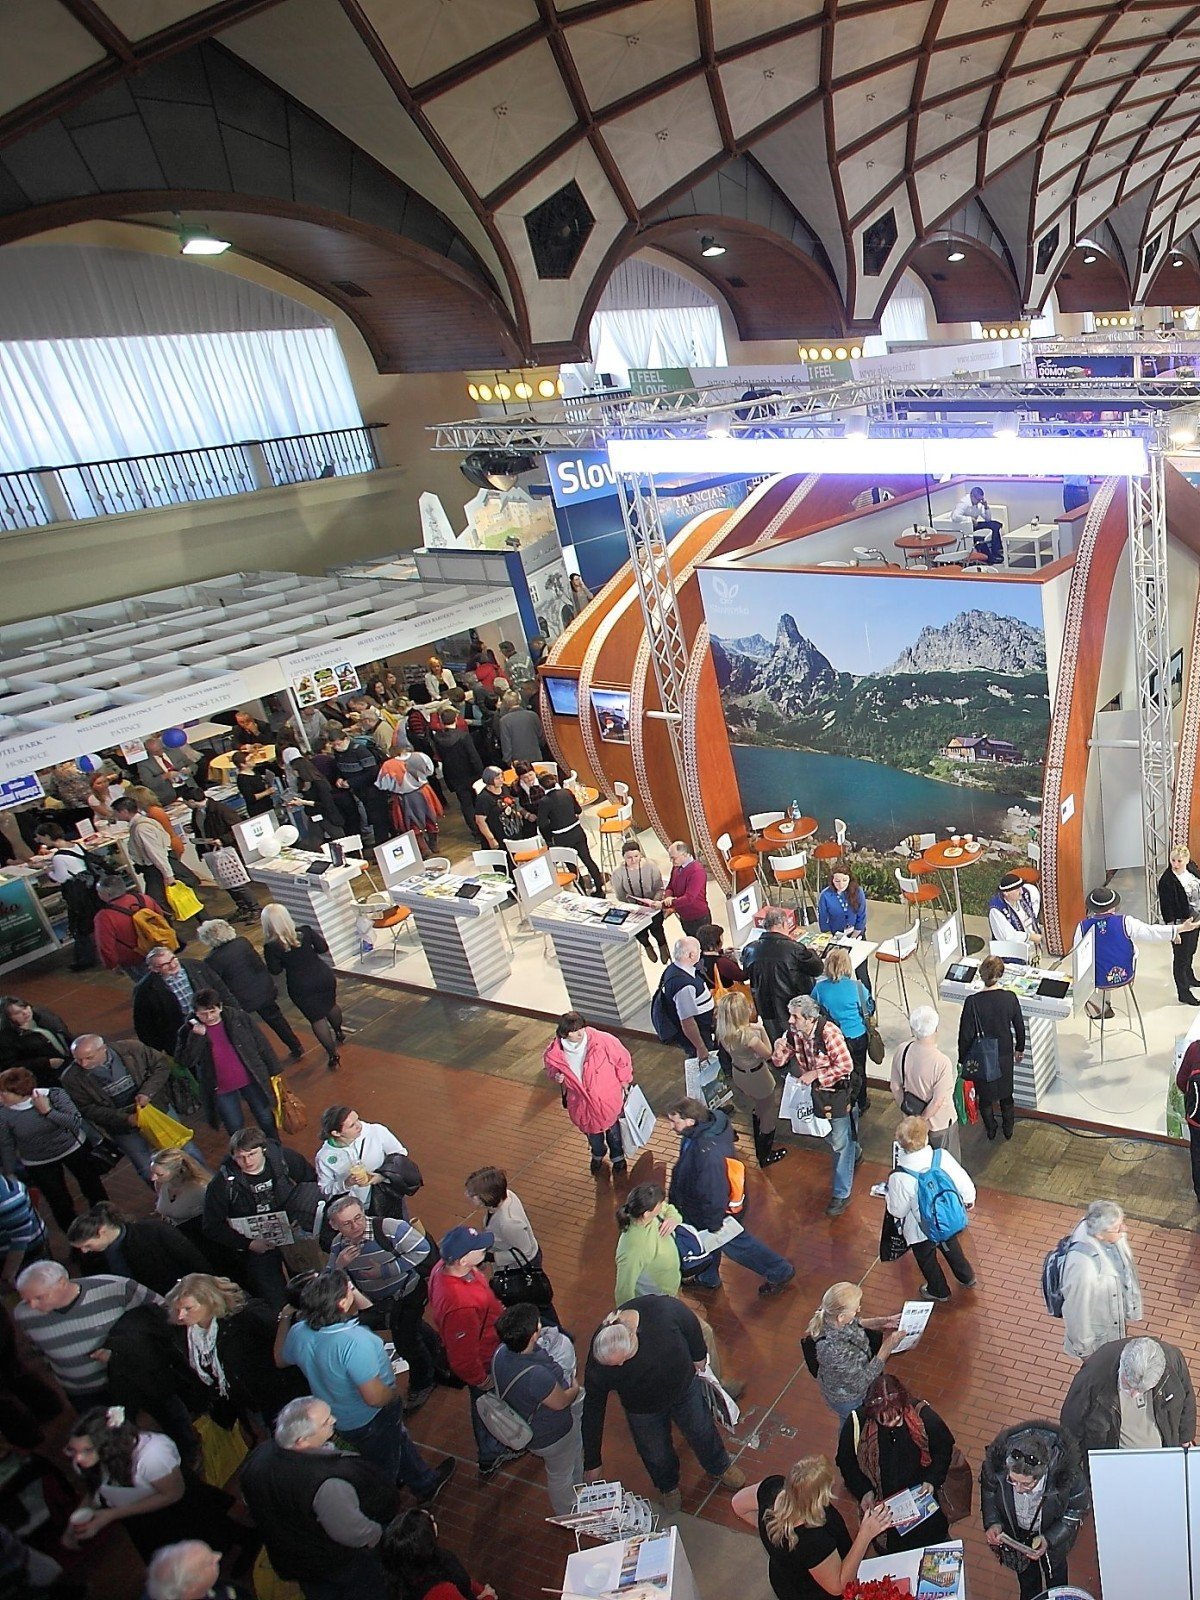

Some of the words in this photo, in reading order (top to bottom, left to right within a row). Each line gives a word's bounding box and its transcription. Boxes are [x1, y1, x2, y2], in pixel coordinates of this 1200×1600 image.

[637, 371, 664, 383] FEEL
[815, 365, 834, 378] FEEL
[1039, 368, 1067, 376] DOMOV
[19, 740, 44, 754] PARK
